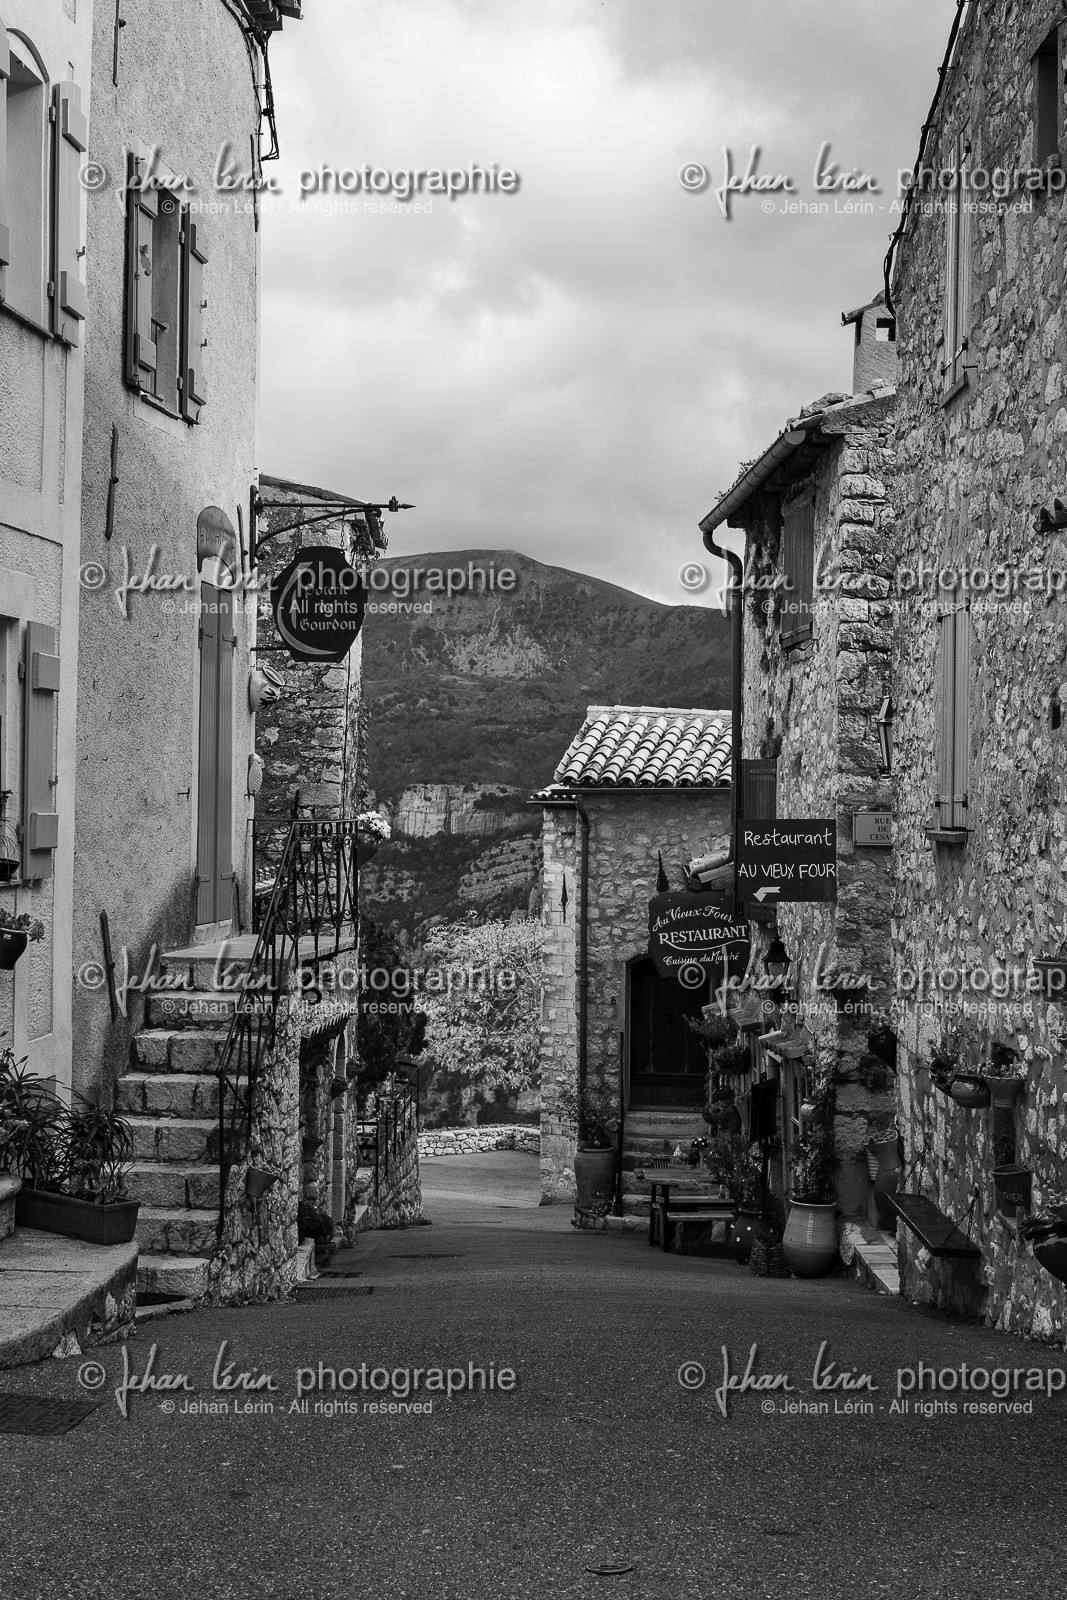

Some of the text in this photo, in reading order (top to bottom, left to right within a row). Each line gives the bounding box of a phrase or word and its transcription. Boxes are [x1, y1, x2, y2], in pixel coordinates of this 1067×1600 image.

[300, 618, 356, 631] Gourdon
[874, 817, 891, 825] RUE
[744, 828, 833, 846] Restaurant
[738, 863, 836, 879] AU VIEUX FOUR
[652, 905, 734, 932] Au Vieux Four
[658, 924, 748, 945] RESTAURANT
[662, 955, 698, 966] Cuisine
